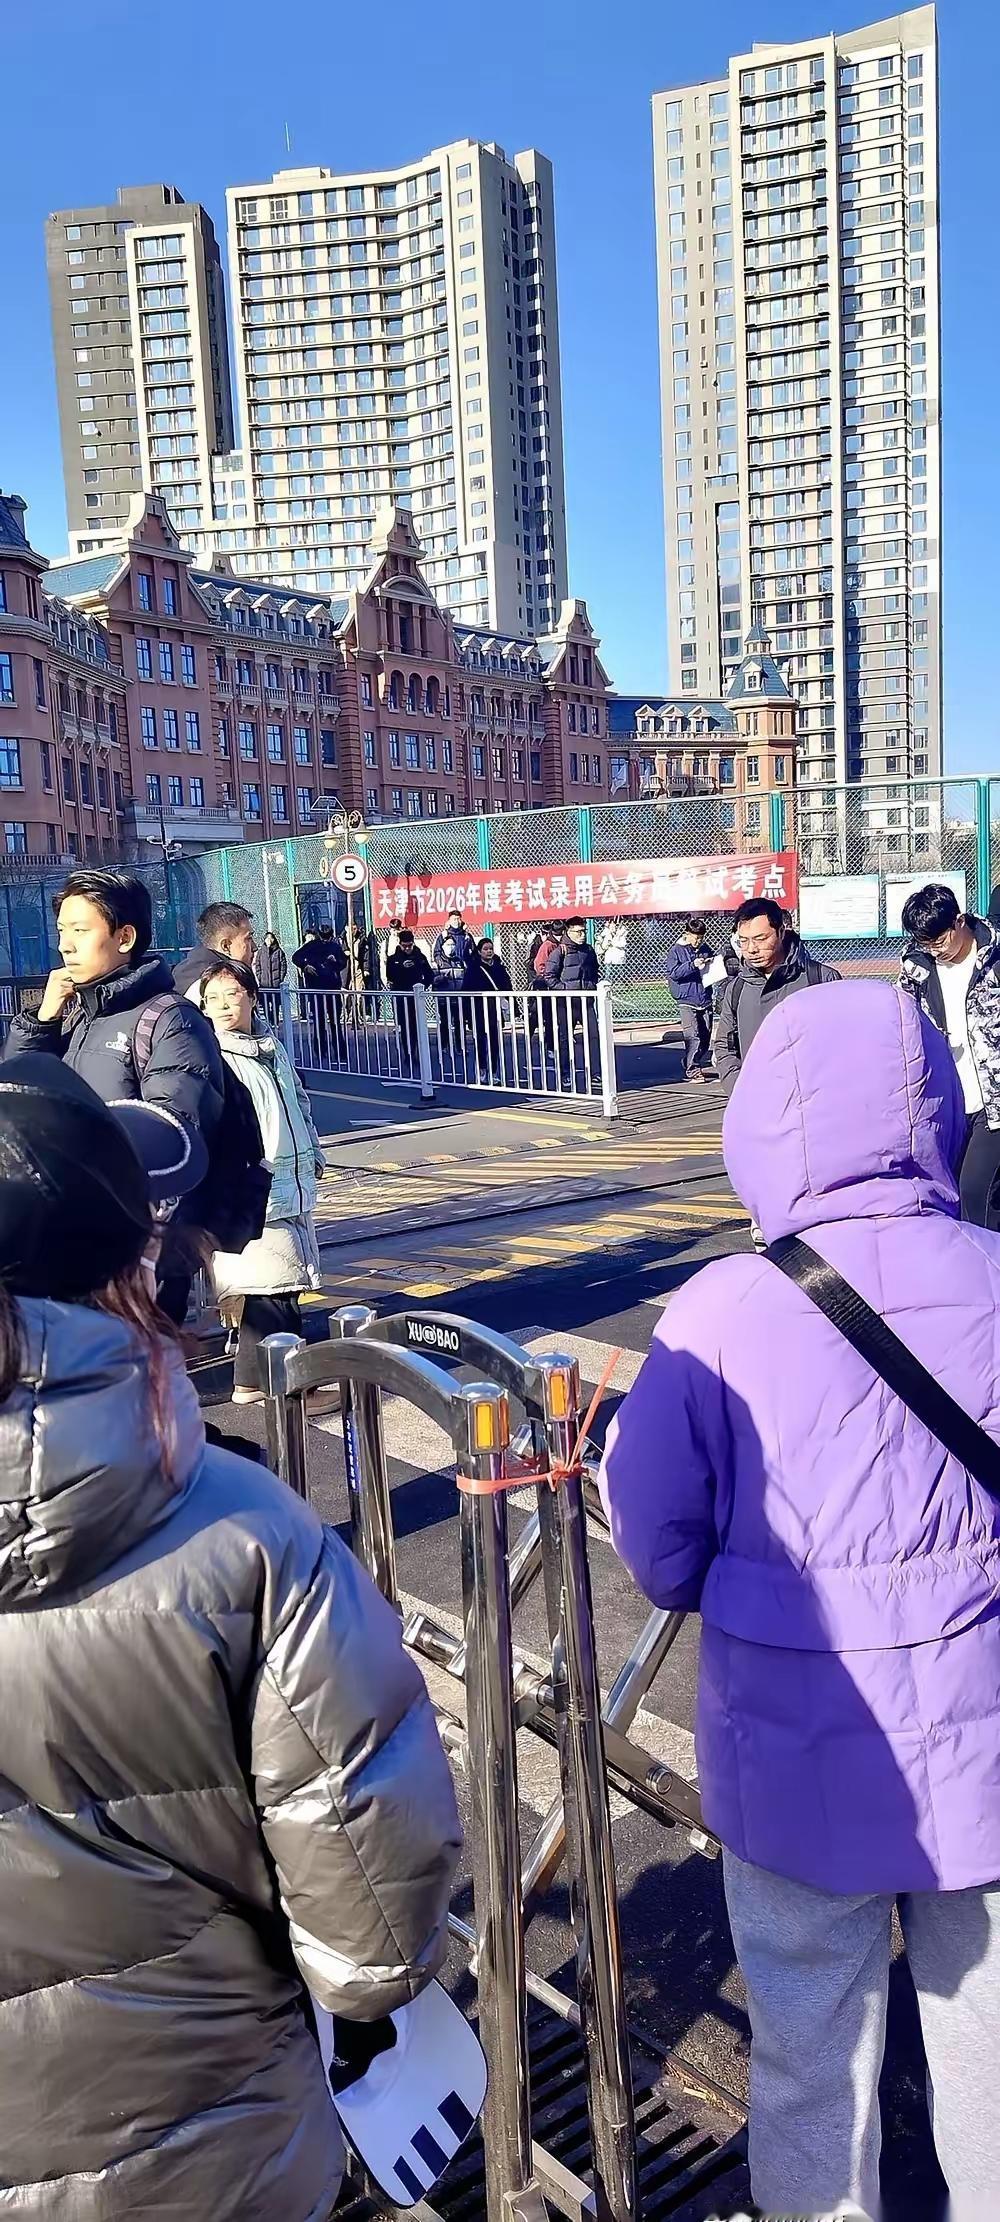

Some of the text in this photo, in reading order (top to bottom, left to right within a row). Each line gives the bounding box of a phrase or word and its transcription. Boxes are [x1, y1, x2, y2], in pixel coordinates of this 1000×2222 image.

[344, 865, 356, 881] 5
[377, 863, 787, 919] 天津市2026年度考试录用公务试考点
